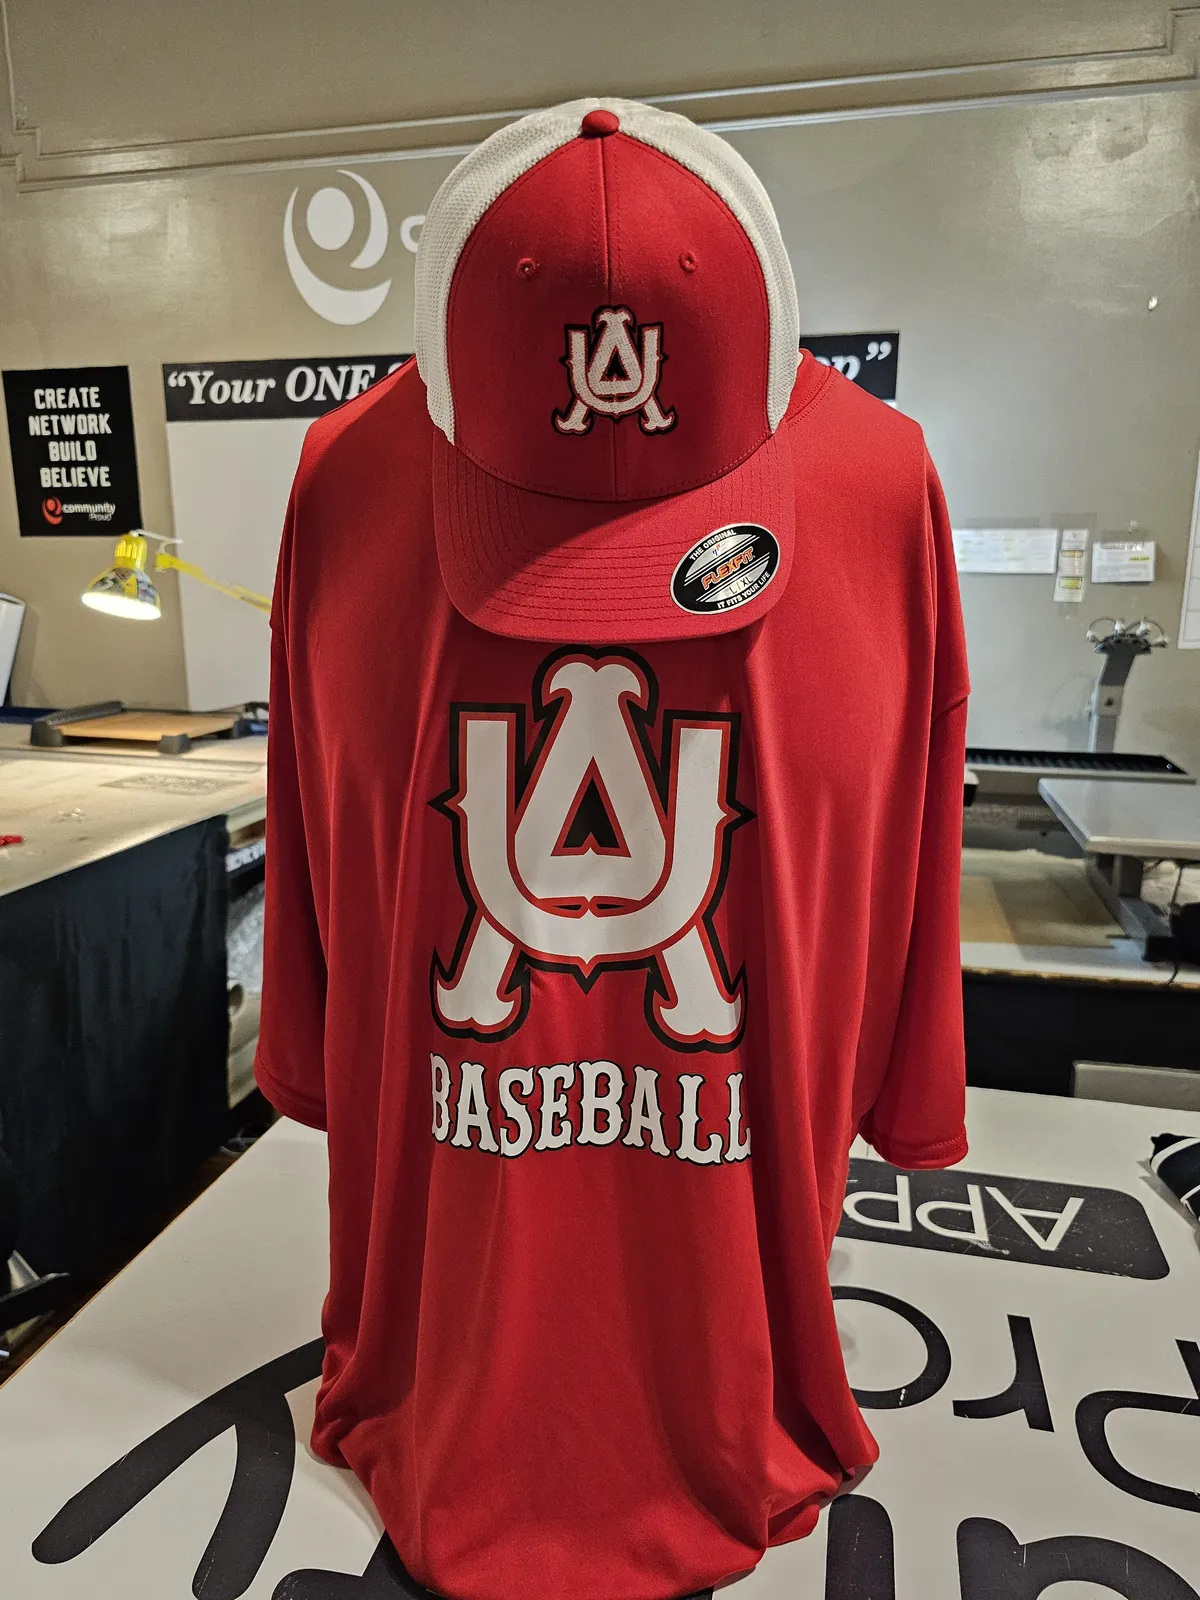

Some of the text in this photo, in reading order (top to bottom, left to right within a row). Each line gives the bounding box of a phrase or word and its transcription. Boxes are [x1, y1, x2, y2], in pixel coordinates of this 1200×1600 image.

[34, 386, 101, 409] CREATE
[28, 413, 113, 436] NETWORK
[48, 440, 97, 462] BUILD
[40, 466, 111, 488] BELIEVE
[62, 502, 116, 515] community
[689, 547, 704, 561] THE
[702, 529, 737, 549] ORIGINAL
[701, 546, 754, 590] FLEXFIT
[726, 595, 742, 607] FITS
[741, 584, 760, 600] YOUR
[759, 571, 771, 585] LIFE
[429, 1052, 752, 1168] BASEBALL
